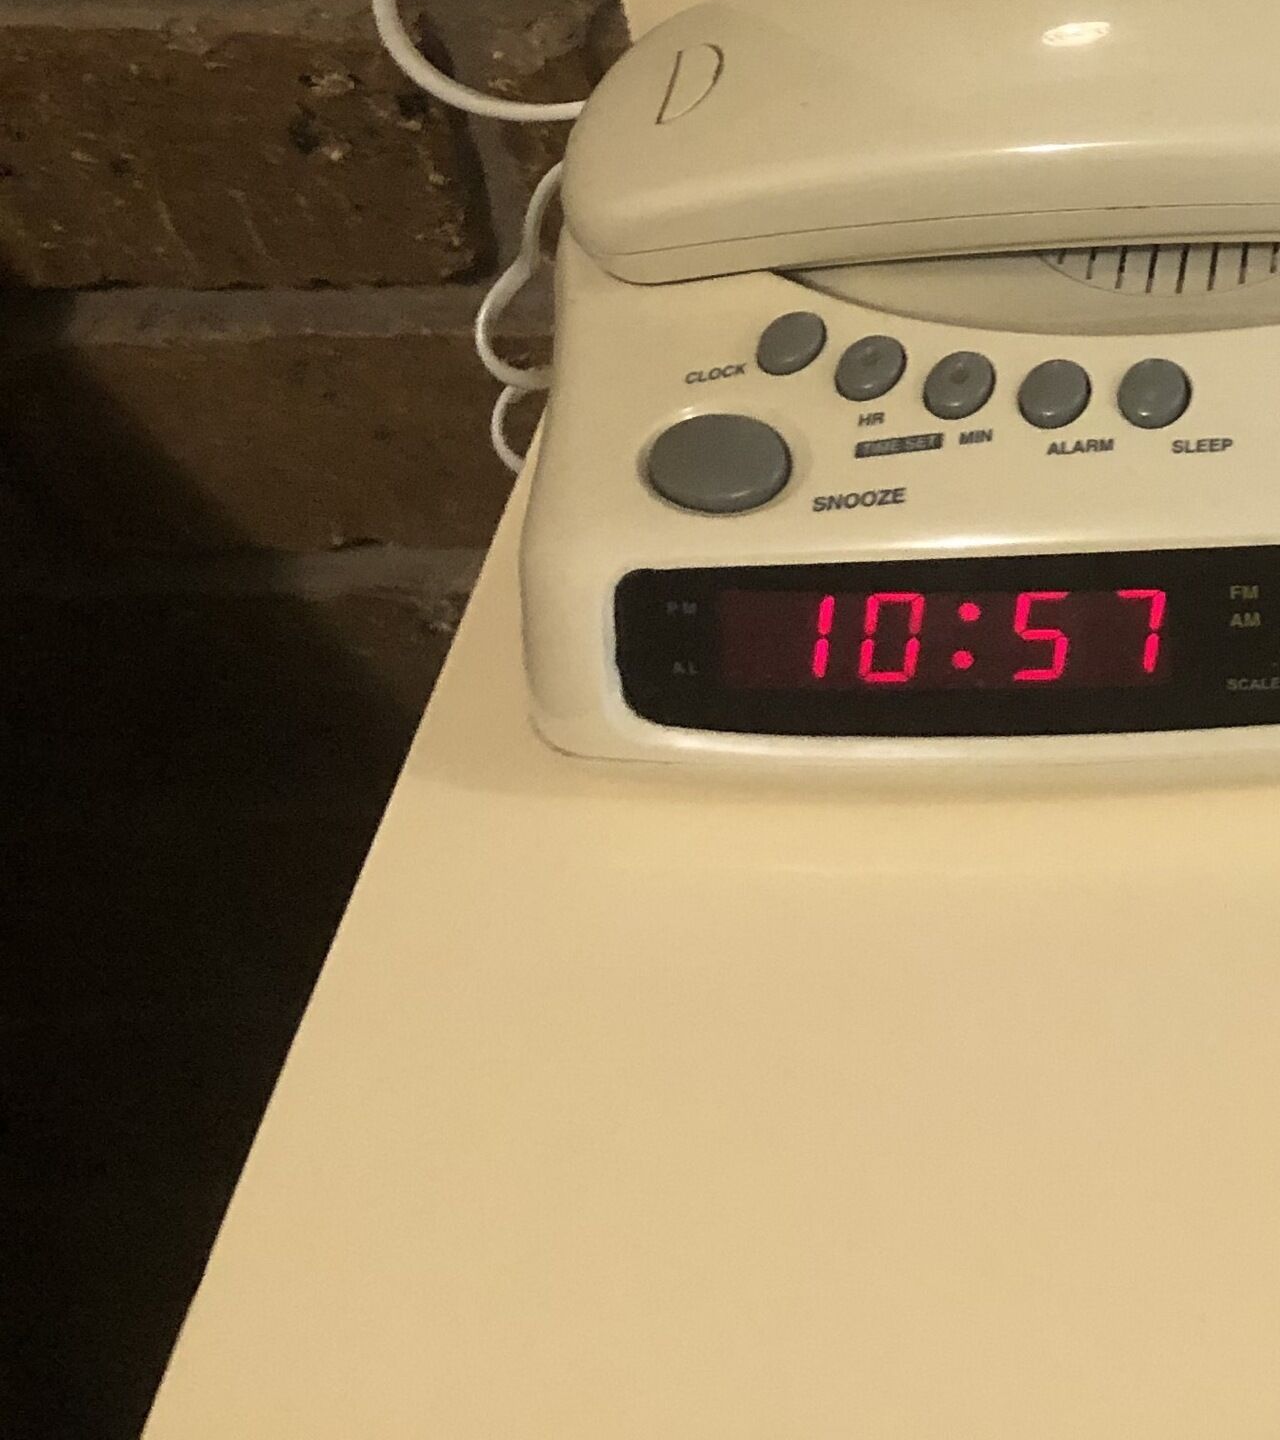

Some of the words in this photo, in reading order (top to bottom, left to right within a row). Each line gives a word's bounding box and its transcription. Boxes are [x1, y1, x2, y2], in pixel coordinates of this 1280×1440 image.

[684, 362, 749, 385] CLOCK
[857, 411, 886, 428] HR
[958, 427, 994, 447] MIN
[1046, 436, 1116, 456] ALARM
[1171, 437, 1234, 455] SLEEP
[812, 487, 907, 512] SNOOZE
[1228, 584, 1261, 600] FM
[1229, 611, 1262, 629] AM
[812, 590, 1167, 683] 10:57
